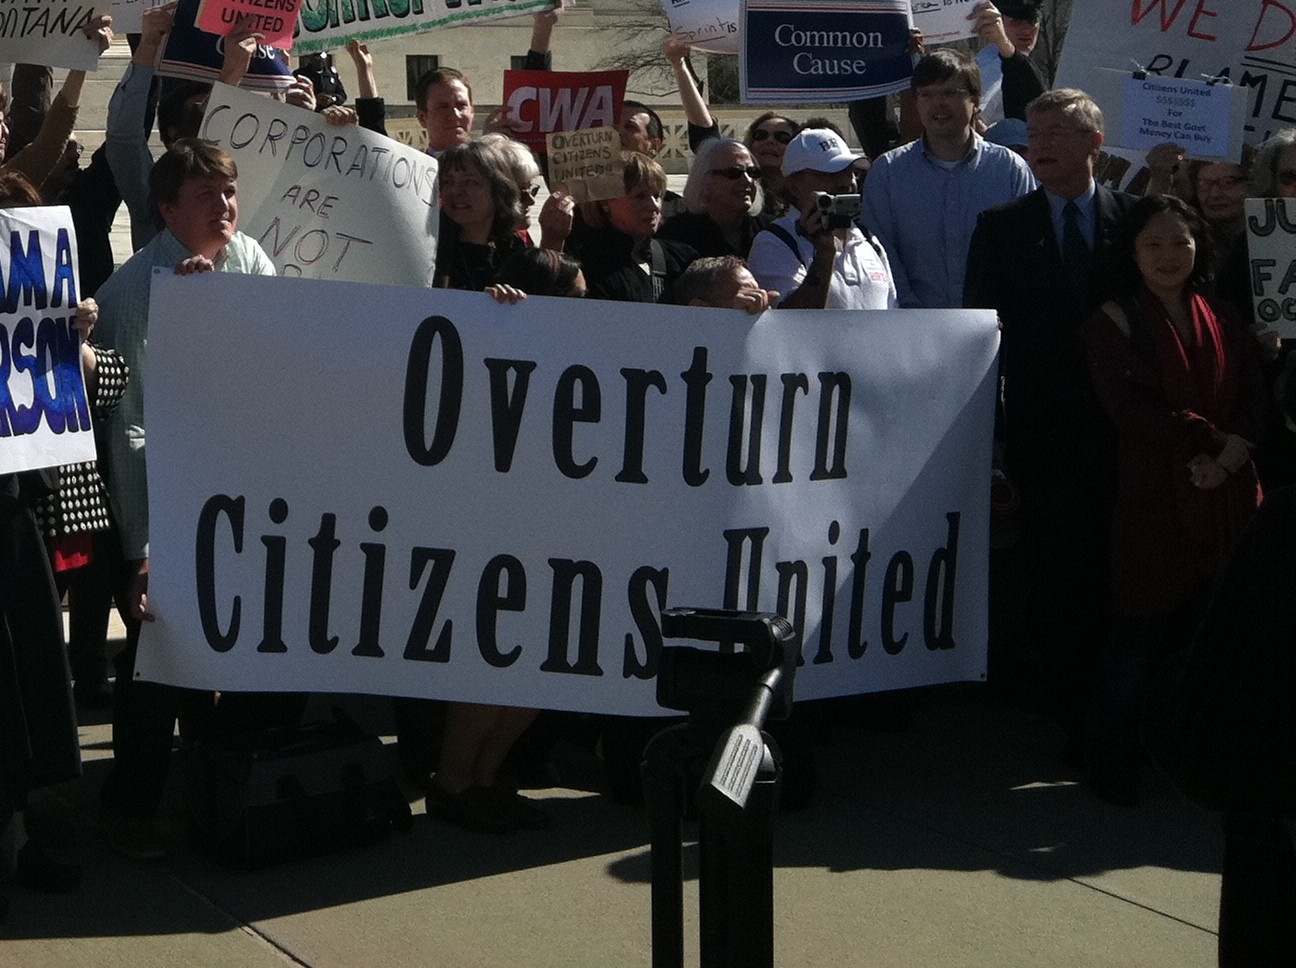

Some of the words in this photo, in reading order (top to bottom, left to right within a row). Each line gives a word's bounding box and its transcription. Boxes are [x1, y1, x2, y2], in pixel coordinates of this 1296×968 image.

[221, 8, 283, 32] UNTED
[774, 23, 883, 49] Common
[792, 52, 868, 75] Cause
[1143, 81, 1178, 94] Citizens
[1180, 86, 1212, 98] United
[506, 85, 614, 133] CWA
[1167, 108, 1184, 118] For
[1138, 127, 1172, 140] Money
[1174, 130, 1192, 141] Can
[1194, 132, 1213, 145] Buy
[1142, 118, 1160, 128] The
[1161, 119, 1182, 130] Best
[551, 132, 613, 150] OVERTURN
[203, 105, 440, 208] CORPORATIONS
[552, 146, 612, 165] CITIZENS
[280, 184, 340, 220] ARE
[258, 215, 374, 273] NOT
[51, 227, 79, 309] A
[403, 315, 852, 487] Overturn
[195, 493, 670, 680] Citizens
